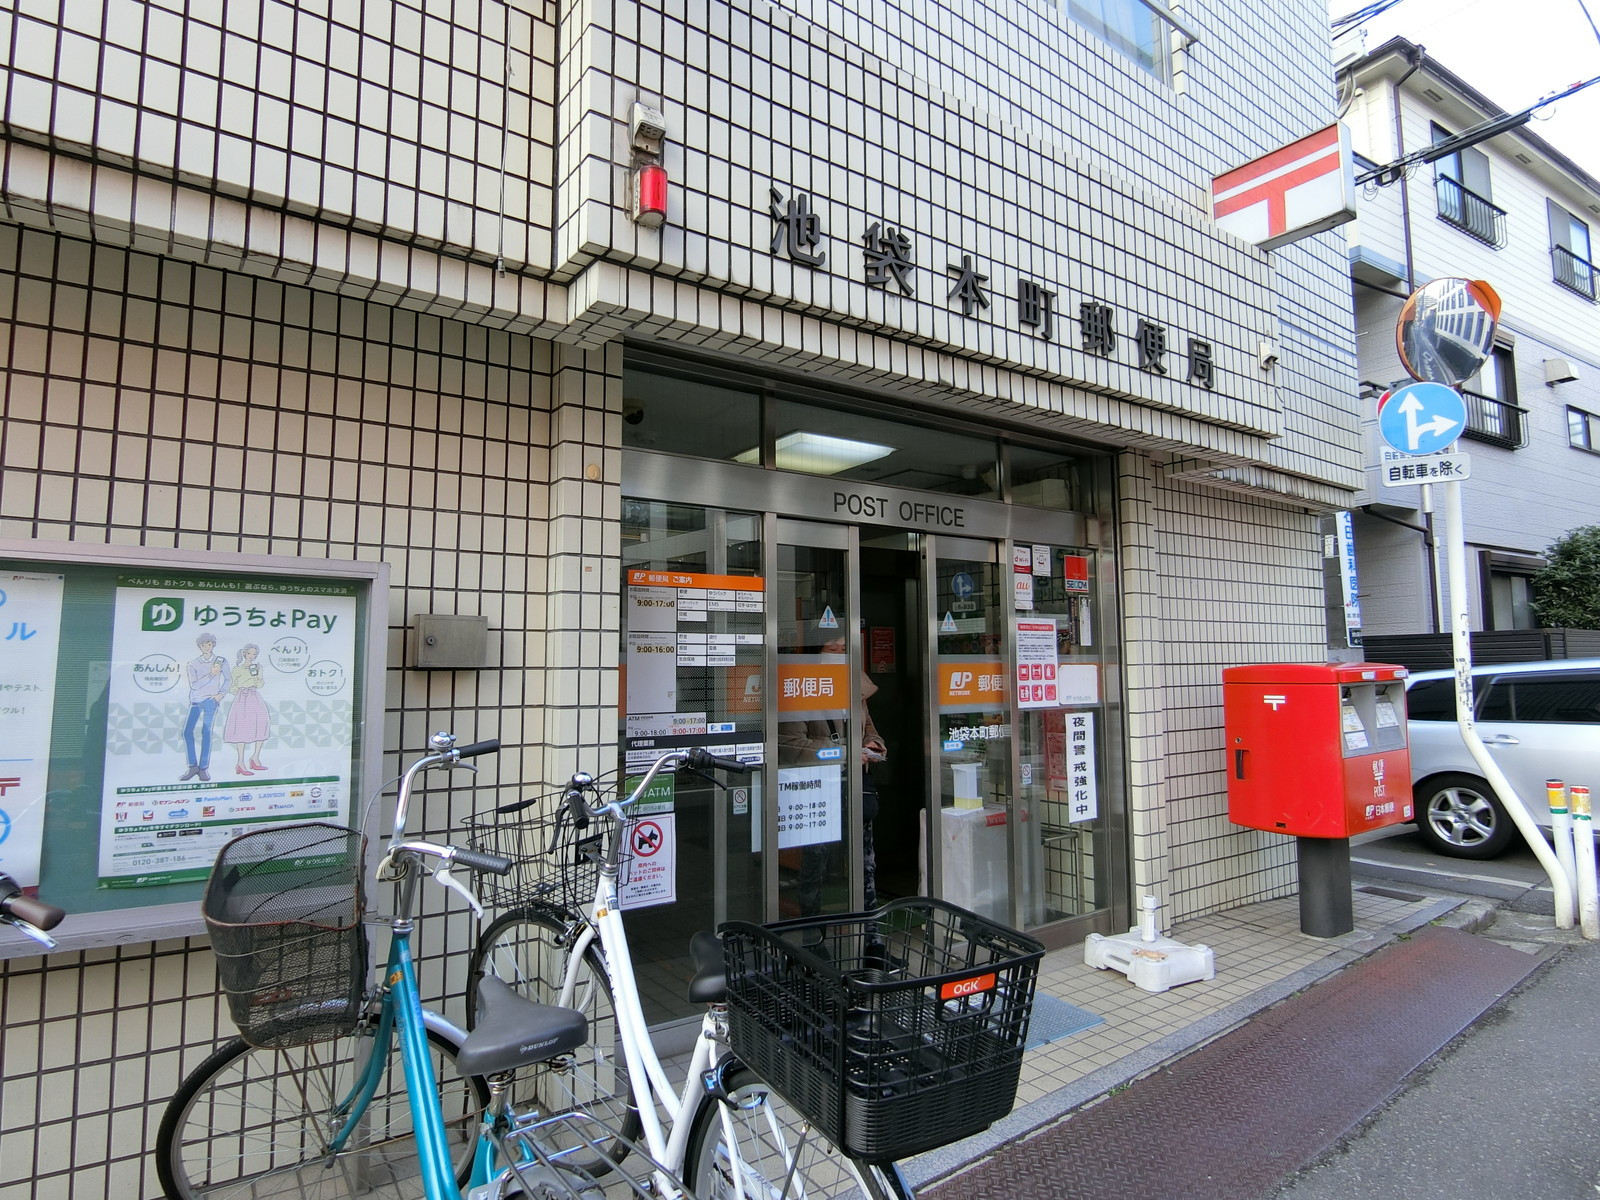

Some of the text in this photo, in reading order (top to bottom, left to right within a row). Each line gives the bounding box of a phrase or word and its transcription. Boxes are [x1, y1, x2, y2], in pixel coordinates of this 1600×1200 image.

[769, 186, 1214, 389] 池袋本町郵便局
[1389, 461, 1463, 481] 自転車を除く
[833, 492, 965, 527] POST OFFICE
[648, 575, 669, 583] 郵便局
[672, 575, 693, 584] ご案内
[1066, 580, 1088, 589] SECOM
[637, 599, 675, 608] 9:00-17:00
[193, 605, 338, 634] ゆうちょPay
[637, 646, 675, 654] 9:00-16:00
[133, 663, 180, 673] あんしん!
[783, 677, 834, 698] 郵便局
[950, 672, 1003, 692] JP 郵便
[1072, 717, 1088, 815] 夜間警戒強化中
[1372, 759, 1384, 774] 郵便
[779, 779, 822, 792] TM稼働時間
[1374, 785, 1385, 797] POST
[1376, 802, 1394, 816] 日本郵便
[132, 856, 186, 866] 0120-387-186
[953, 980, 979, 994] OGK
[527, 1037, 559, 1050] DUNLOP
